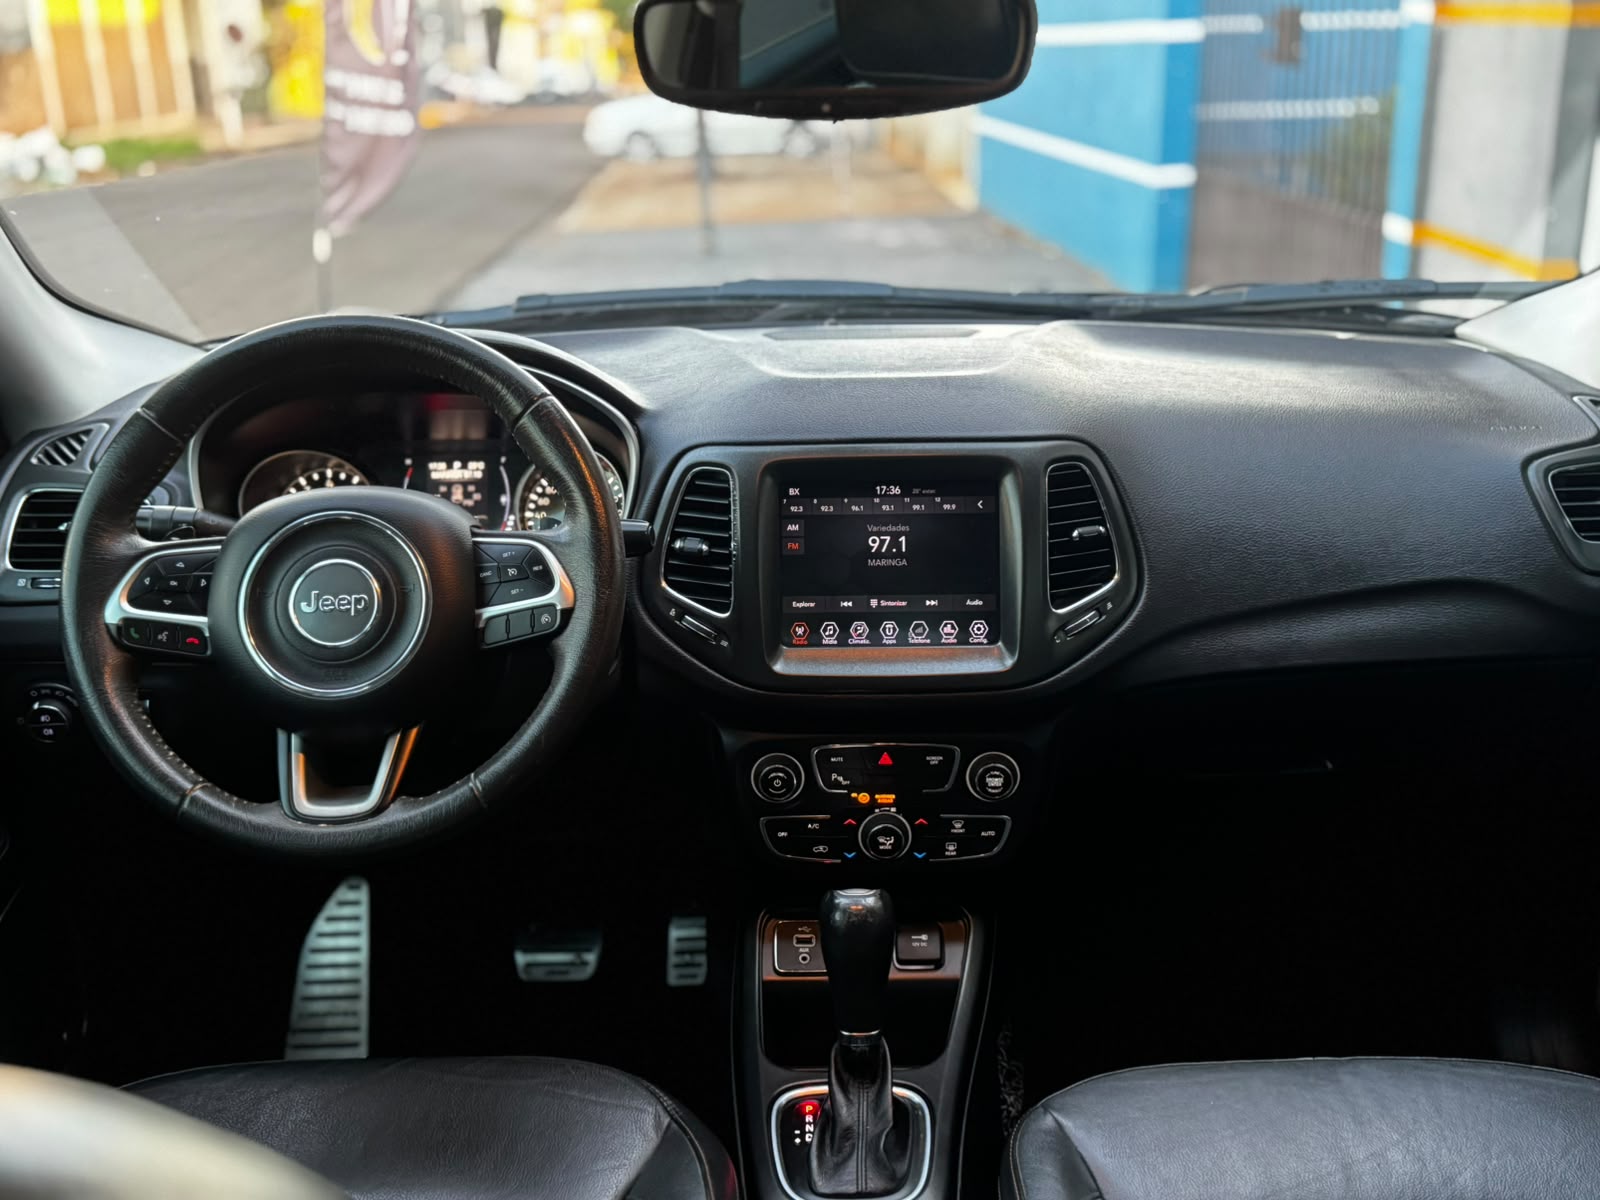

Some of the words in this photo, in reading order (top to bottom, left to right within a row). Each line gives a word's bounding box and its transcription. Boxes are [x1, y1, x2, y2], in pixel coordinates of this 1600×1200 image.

[789, 488, 800, 496] BX
[876, 486, 900, 494] 17:36
[867, 524, 910, 532] Variedades
[868, 536, 906, 552] 97.1
[300, 590, 368, 616] Jeep
[806, 1114, 814, 1122] R
[806, 1124, 814, 1132] N
